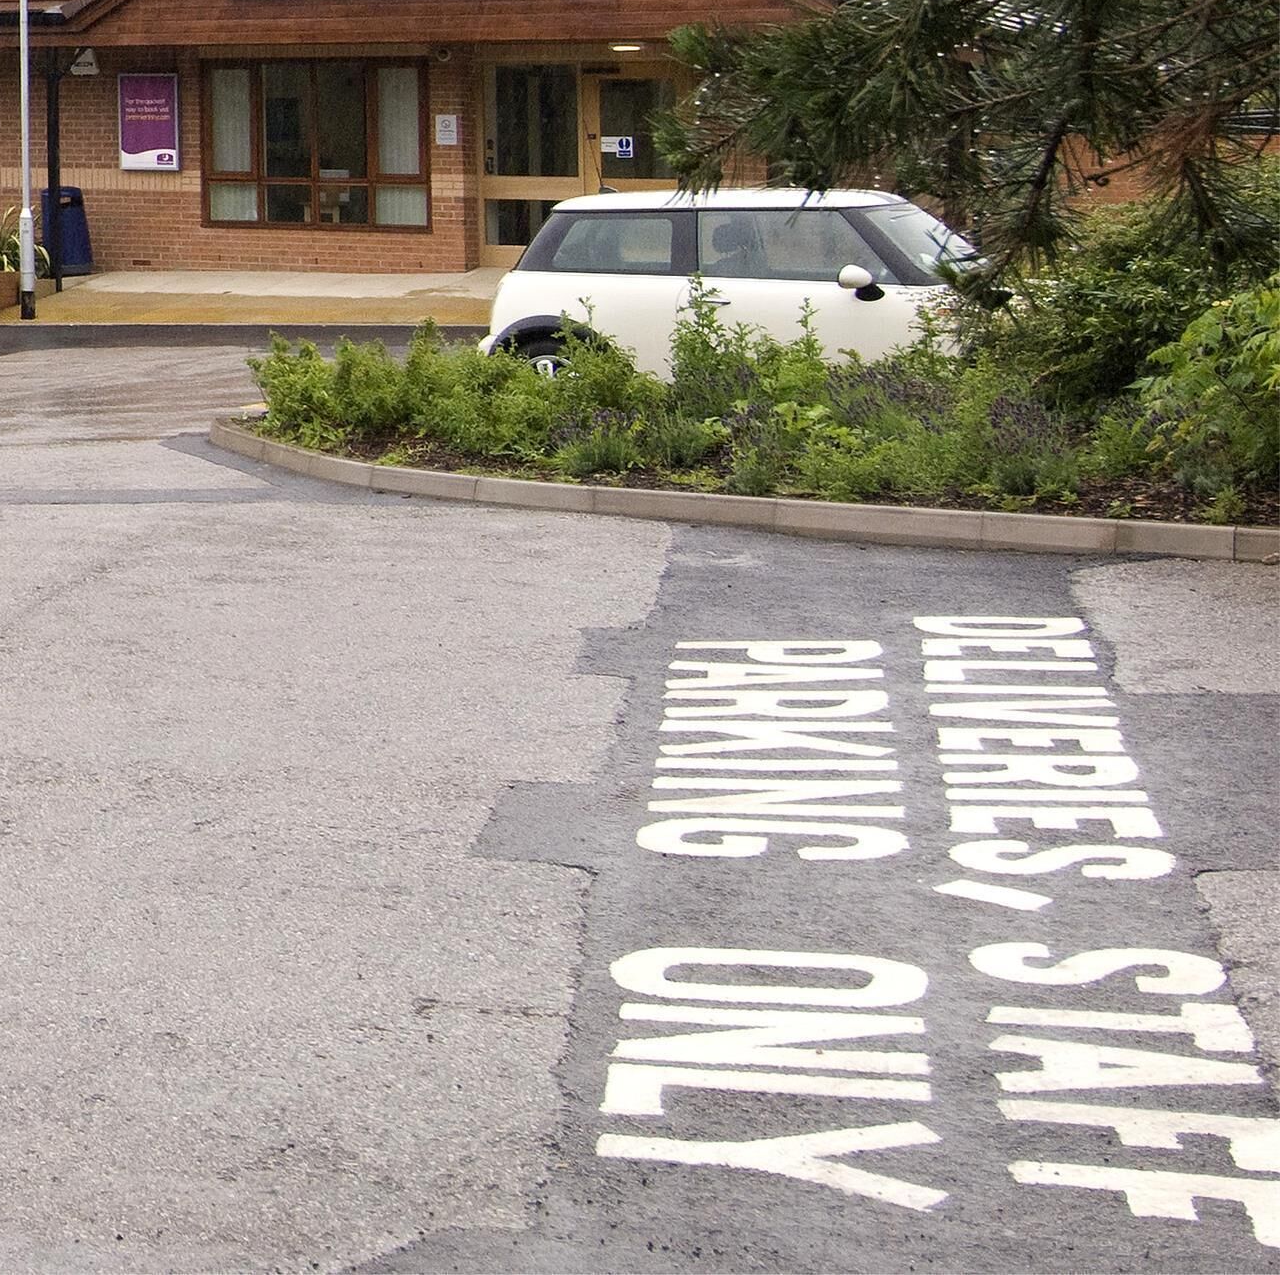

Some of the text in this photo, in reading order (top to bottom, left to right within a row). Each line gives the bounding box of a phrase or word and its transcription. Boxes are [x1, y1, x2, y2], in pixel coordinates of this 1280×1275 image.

[596, 640, 949, 1211] PARKING ONLY
[913, 616, 1280, 1248] DELIVERIES, STAFF
